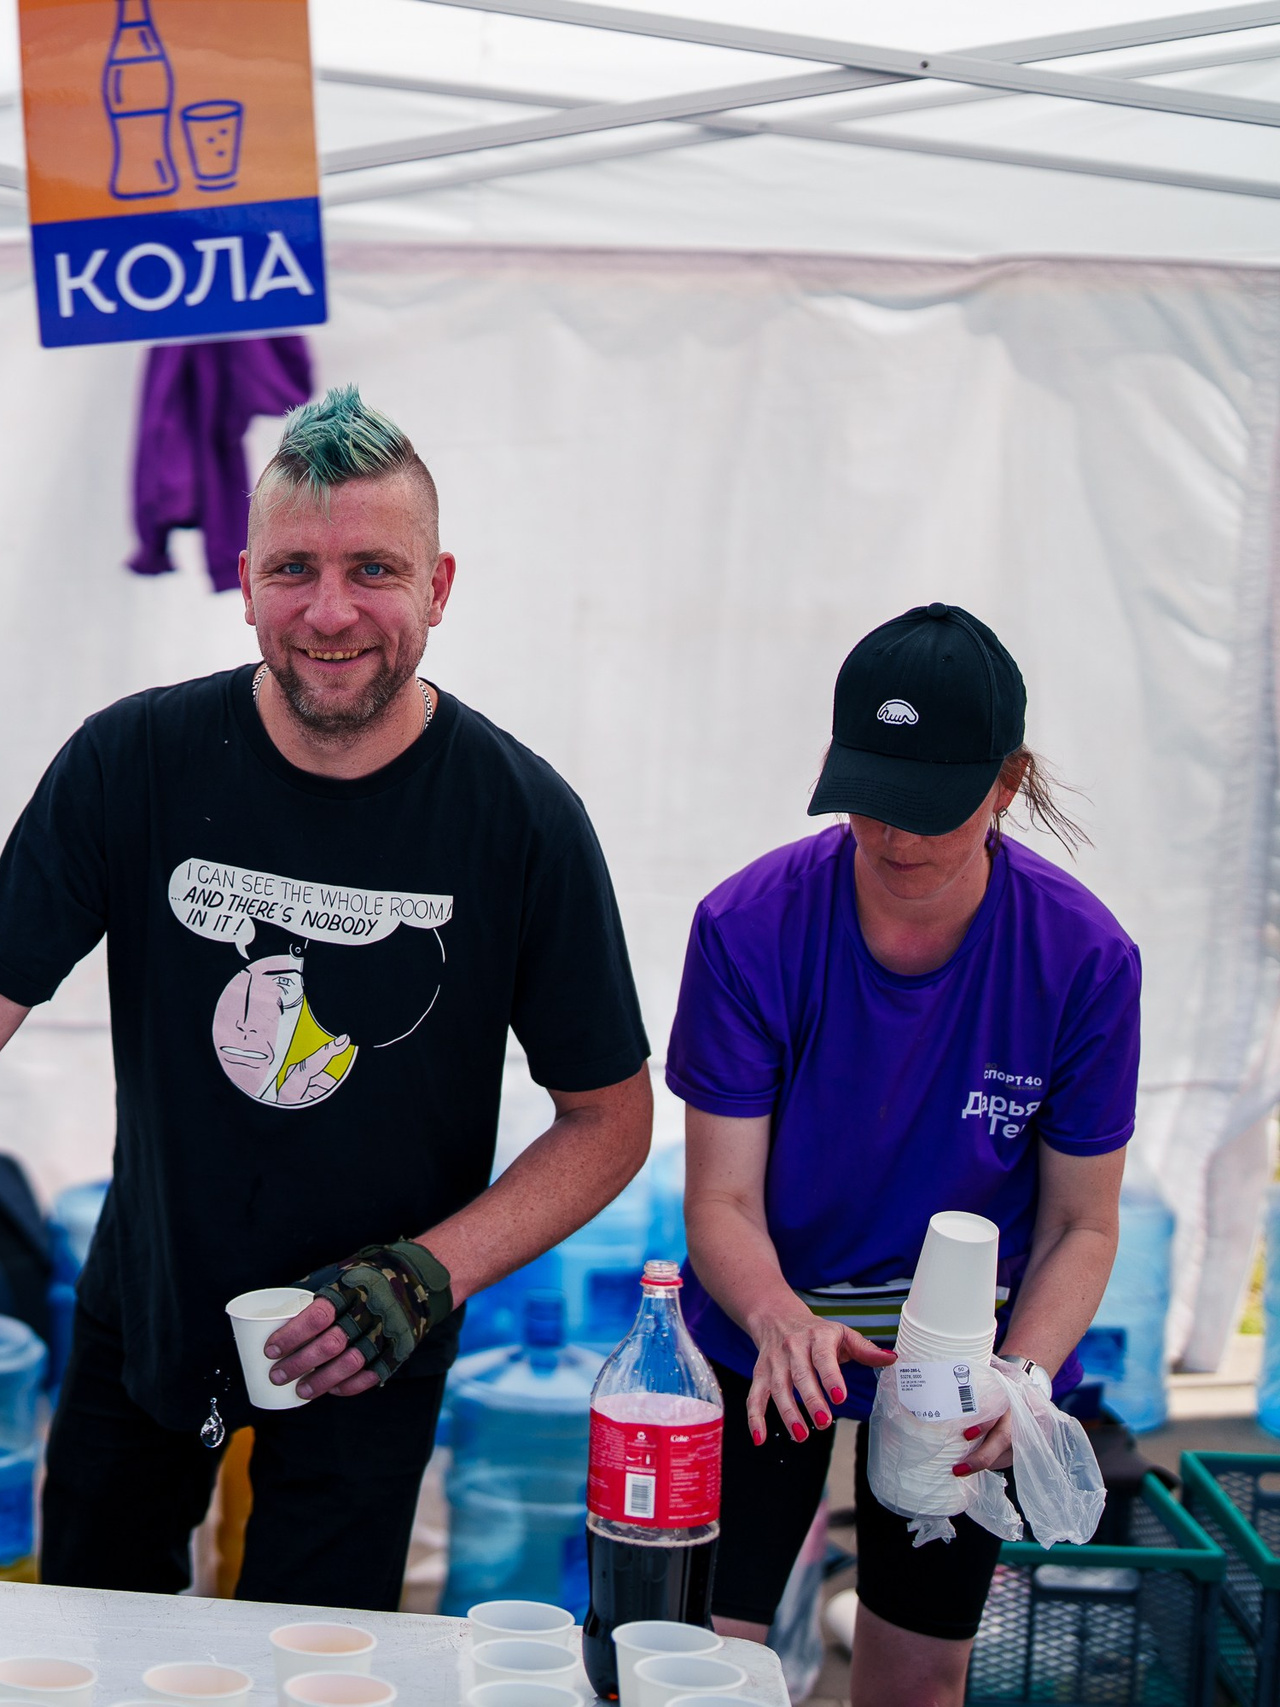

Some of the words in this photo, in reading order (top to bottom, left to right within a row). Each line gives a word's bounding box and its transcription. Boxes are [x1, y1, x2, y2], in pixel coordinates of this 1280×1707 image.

[55, 230, 315, 318] КОЛА
[186, 862, 192, 881] I
[197, 865, 236, 889] CAN
[241, 874, 275, 896] SEE
[281, 881, 314, 904] THE
[320, 888, 384, 916] WHOLE
[390, 897, 453, 921] ROOM!
[185, 908, 207, 928] IN
[227, 893, 295, 923] THERE'S
[300, 910, 379, 937] NOBODY
[1024, 1076, 1043, 1087] 40
[961, 1091, 1042, 1119] Дарья
[989, 1113, 1026, 1139] Ге
